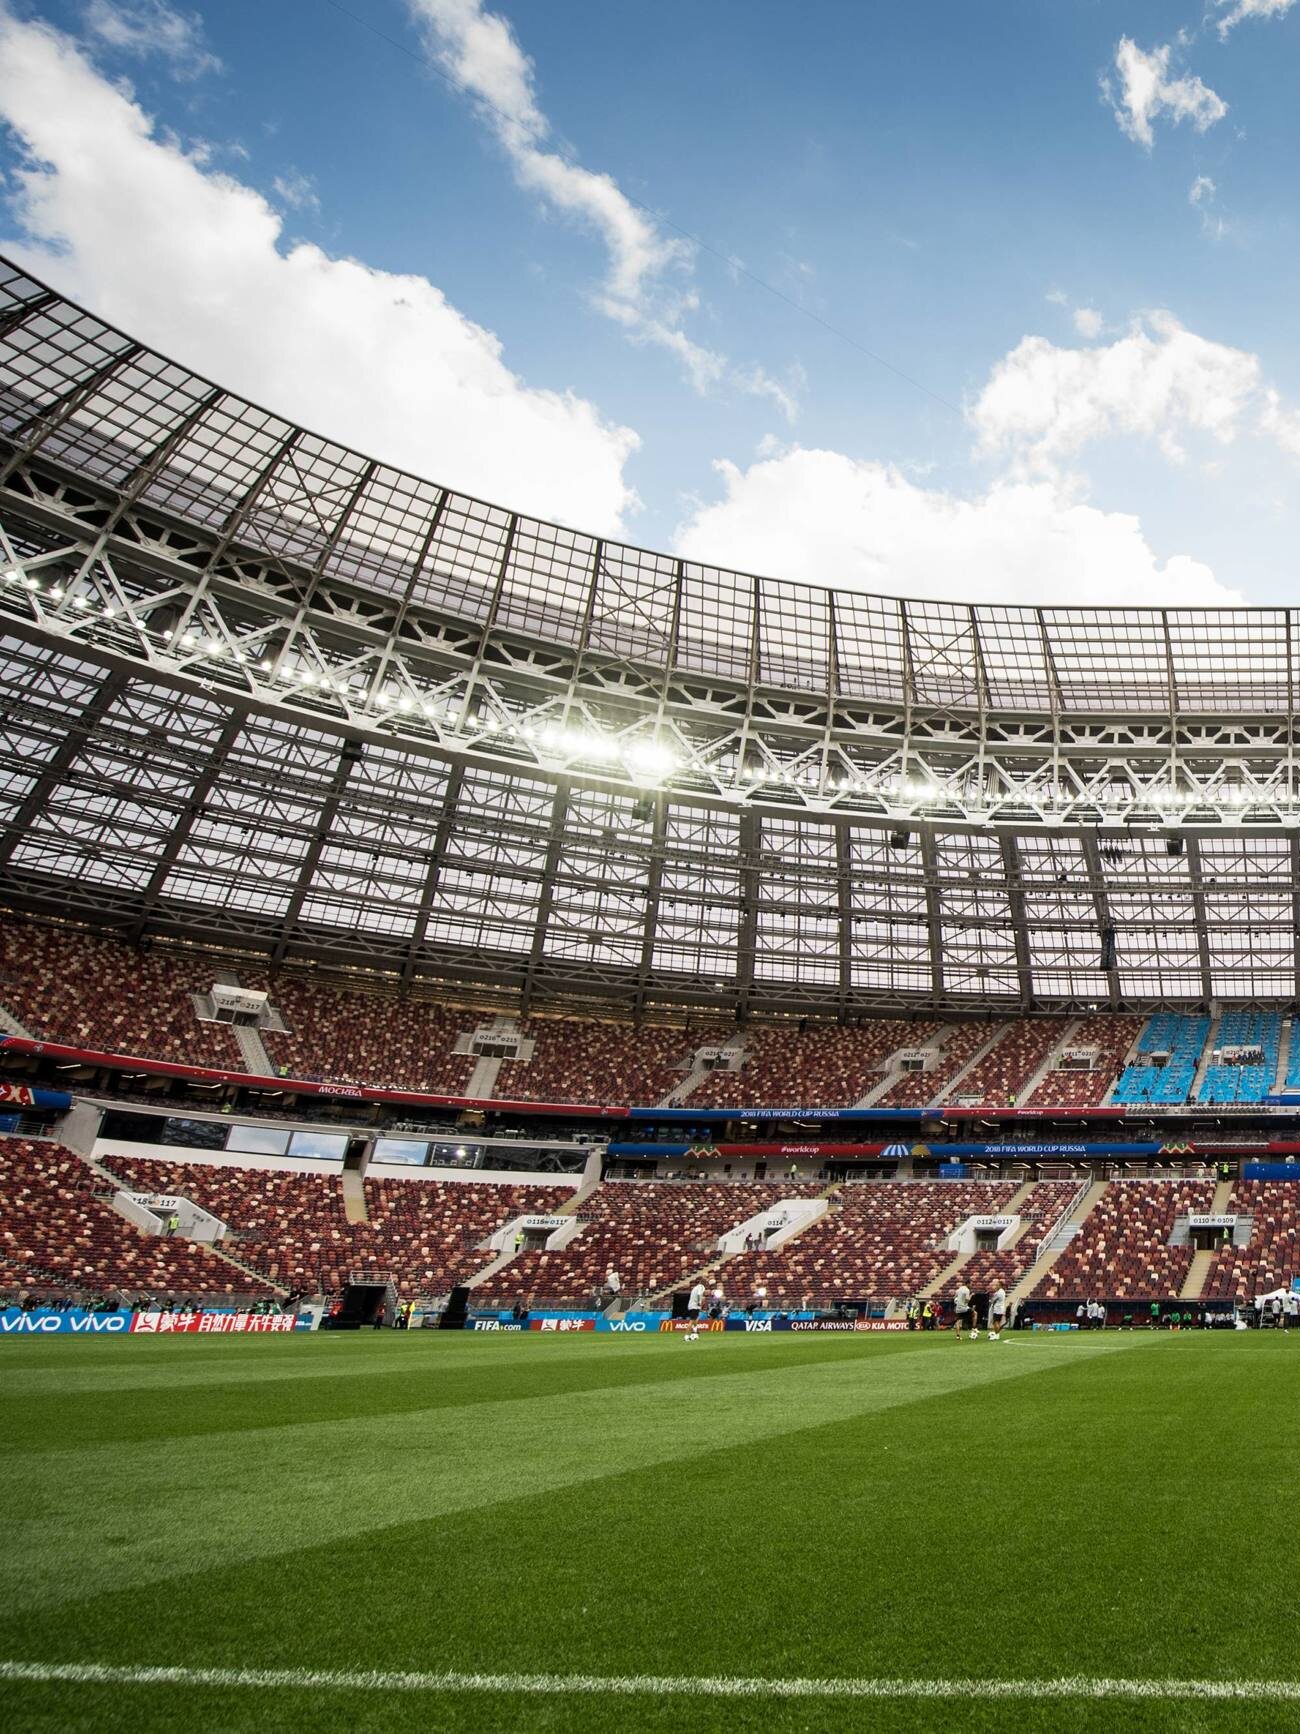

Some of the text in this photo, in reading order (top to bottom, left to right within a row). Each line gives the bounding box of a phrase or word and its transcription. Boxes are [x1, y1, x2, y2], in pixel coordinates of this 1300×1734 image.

[1, 1312, 62, 1331] vivo
[69, 1312, 125, 1331] vivo
[609, 1320, 646, 1331] vivo
[744, 1320, 772, 1332] VISA
[820, 1321, 854, 1330] AIRWAYS
[871, 1322, 886, 1330] KIA
